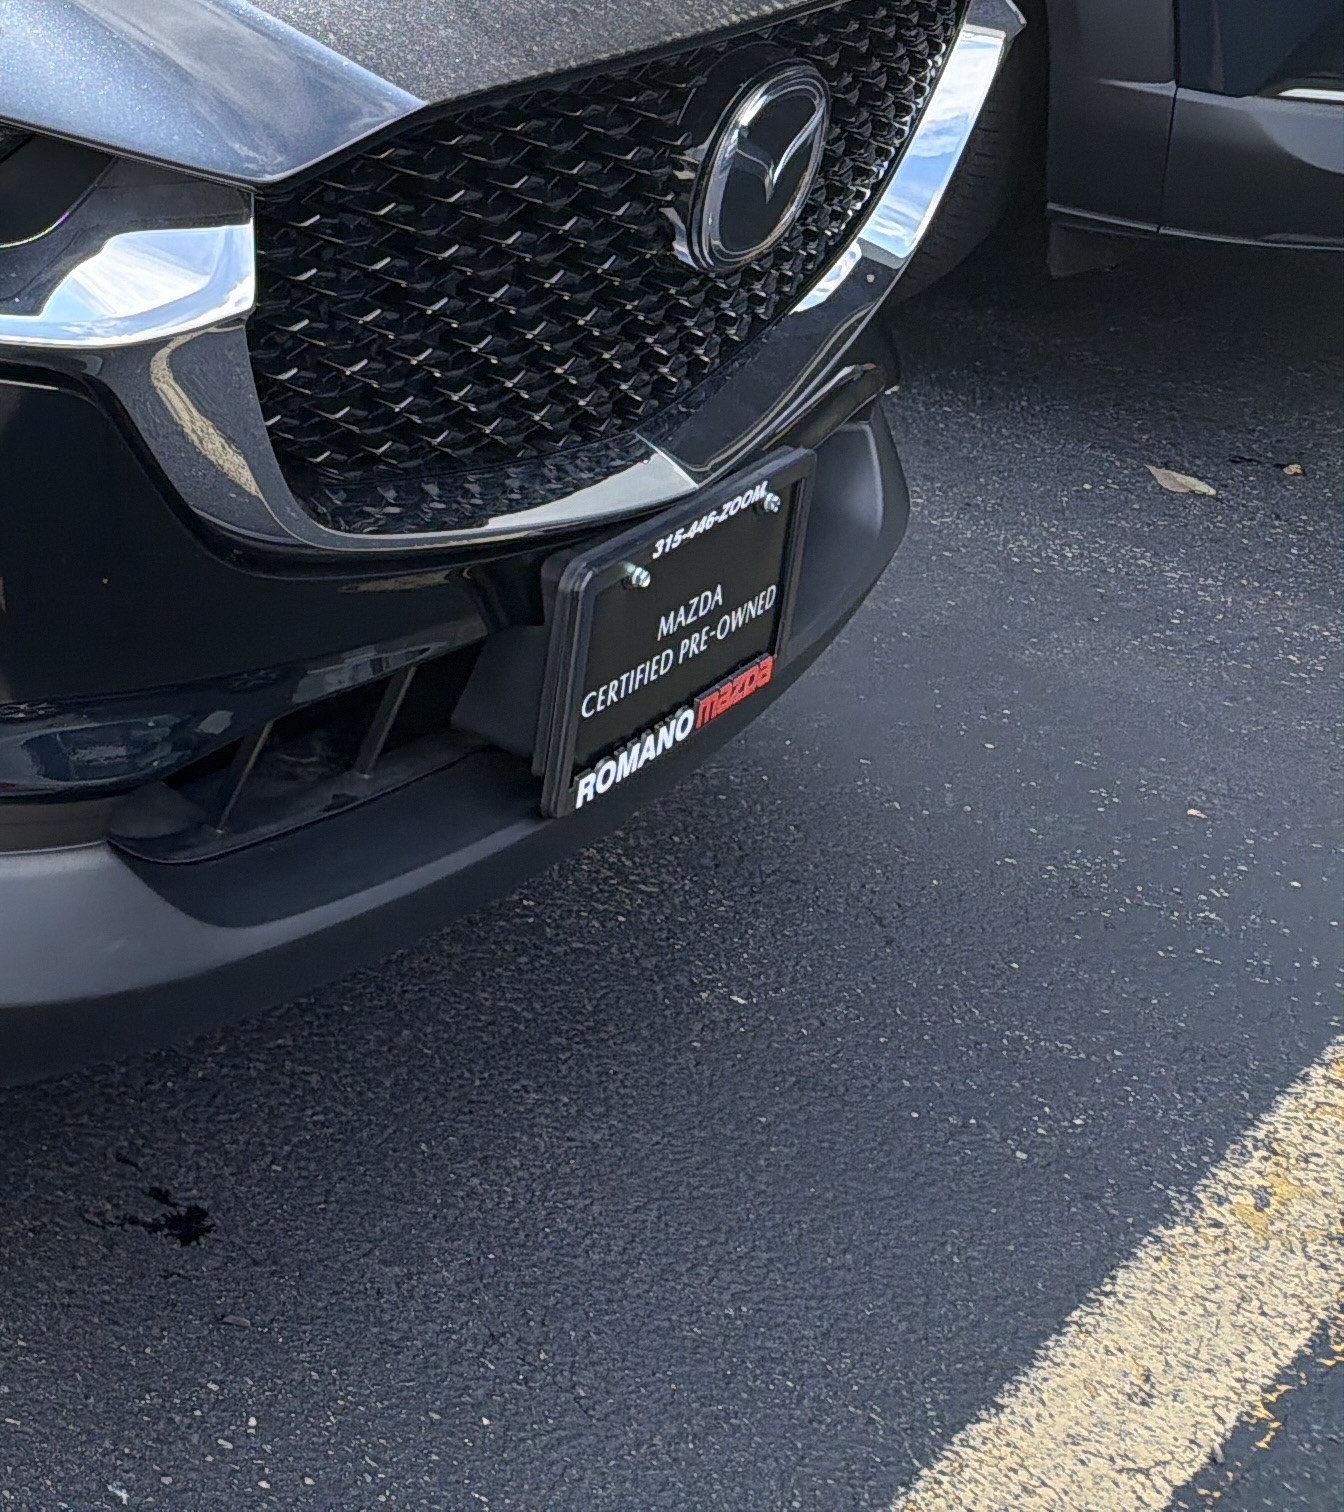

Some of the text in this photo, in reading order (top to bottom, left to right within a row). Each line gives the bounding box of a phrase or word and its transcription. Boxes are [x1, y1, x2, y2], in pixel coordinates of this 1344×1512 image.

[652, 481, 768, 559] 315-446-ZOOM
[581, 584, 777, 718] CERTIFIED PRE-OWNED
[657, 584, 723, 641] MAZDA
[575, 655, 774, 809] ROMANO mazda
